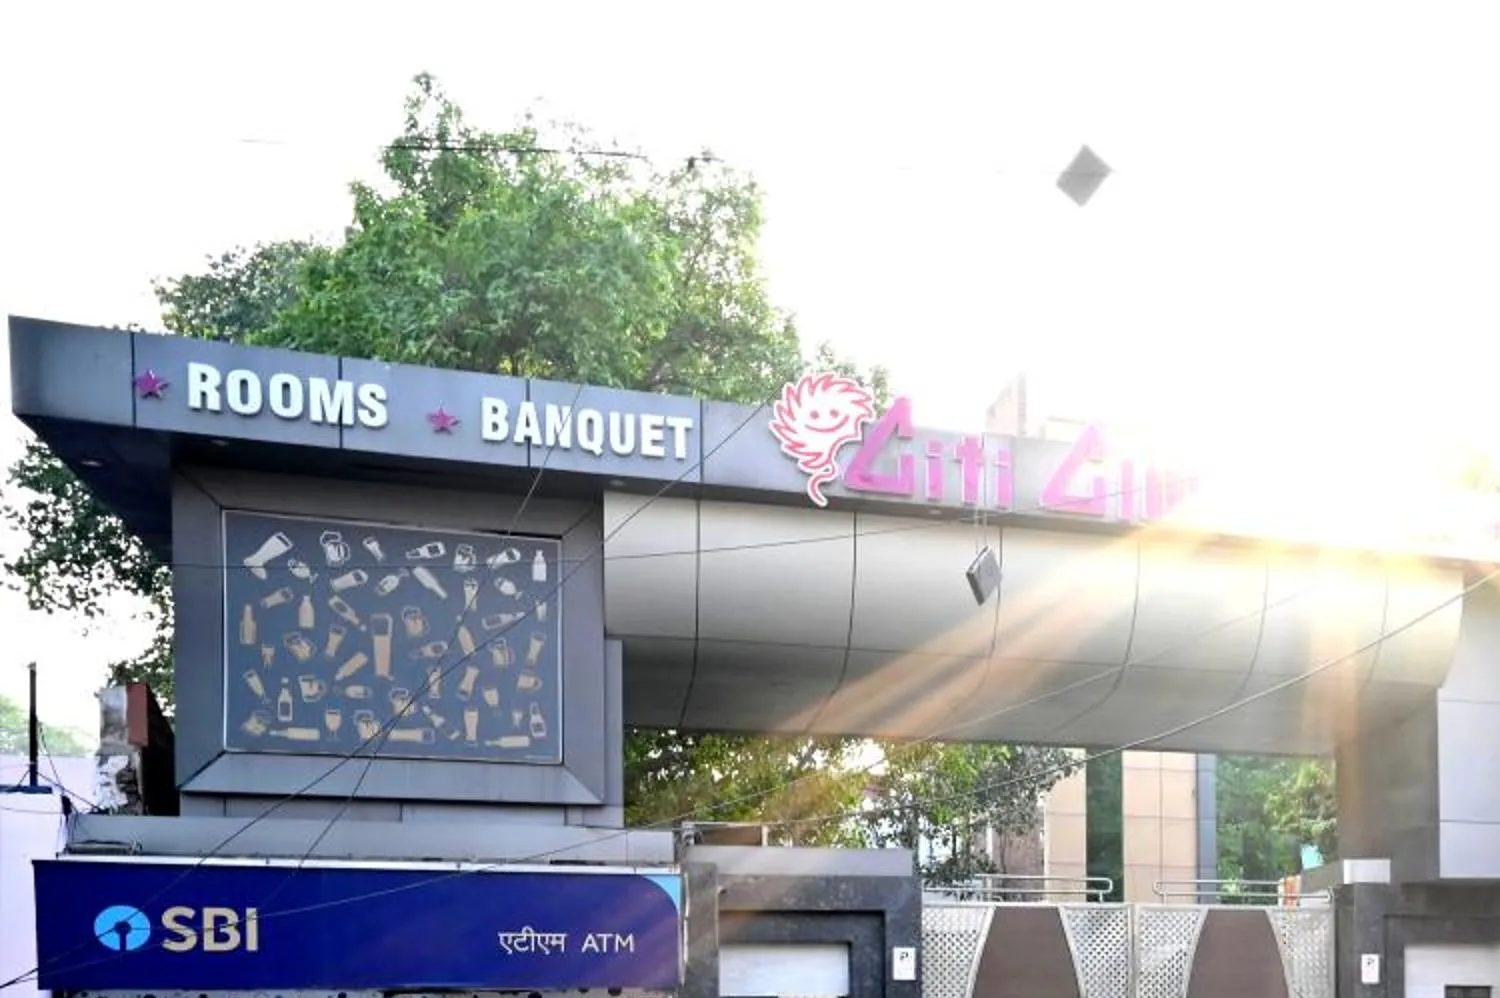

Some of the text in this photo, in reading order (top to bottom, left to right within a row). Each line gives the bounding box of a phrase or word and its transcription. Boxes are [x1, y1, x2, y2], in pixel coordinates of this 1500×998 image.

[187, 361, 389, 427] ROOMS
[481, 397, 694, 459] BANQUET
[161, 905, 259, 952] SBI
[498, 925, 635, 955] एटीएम ATM
